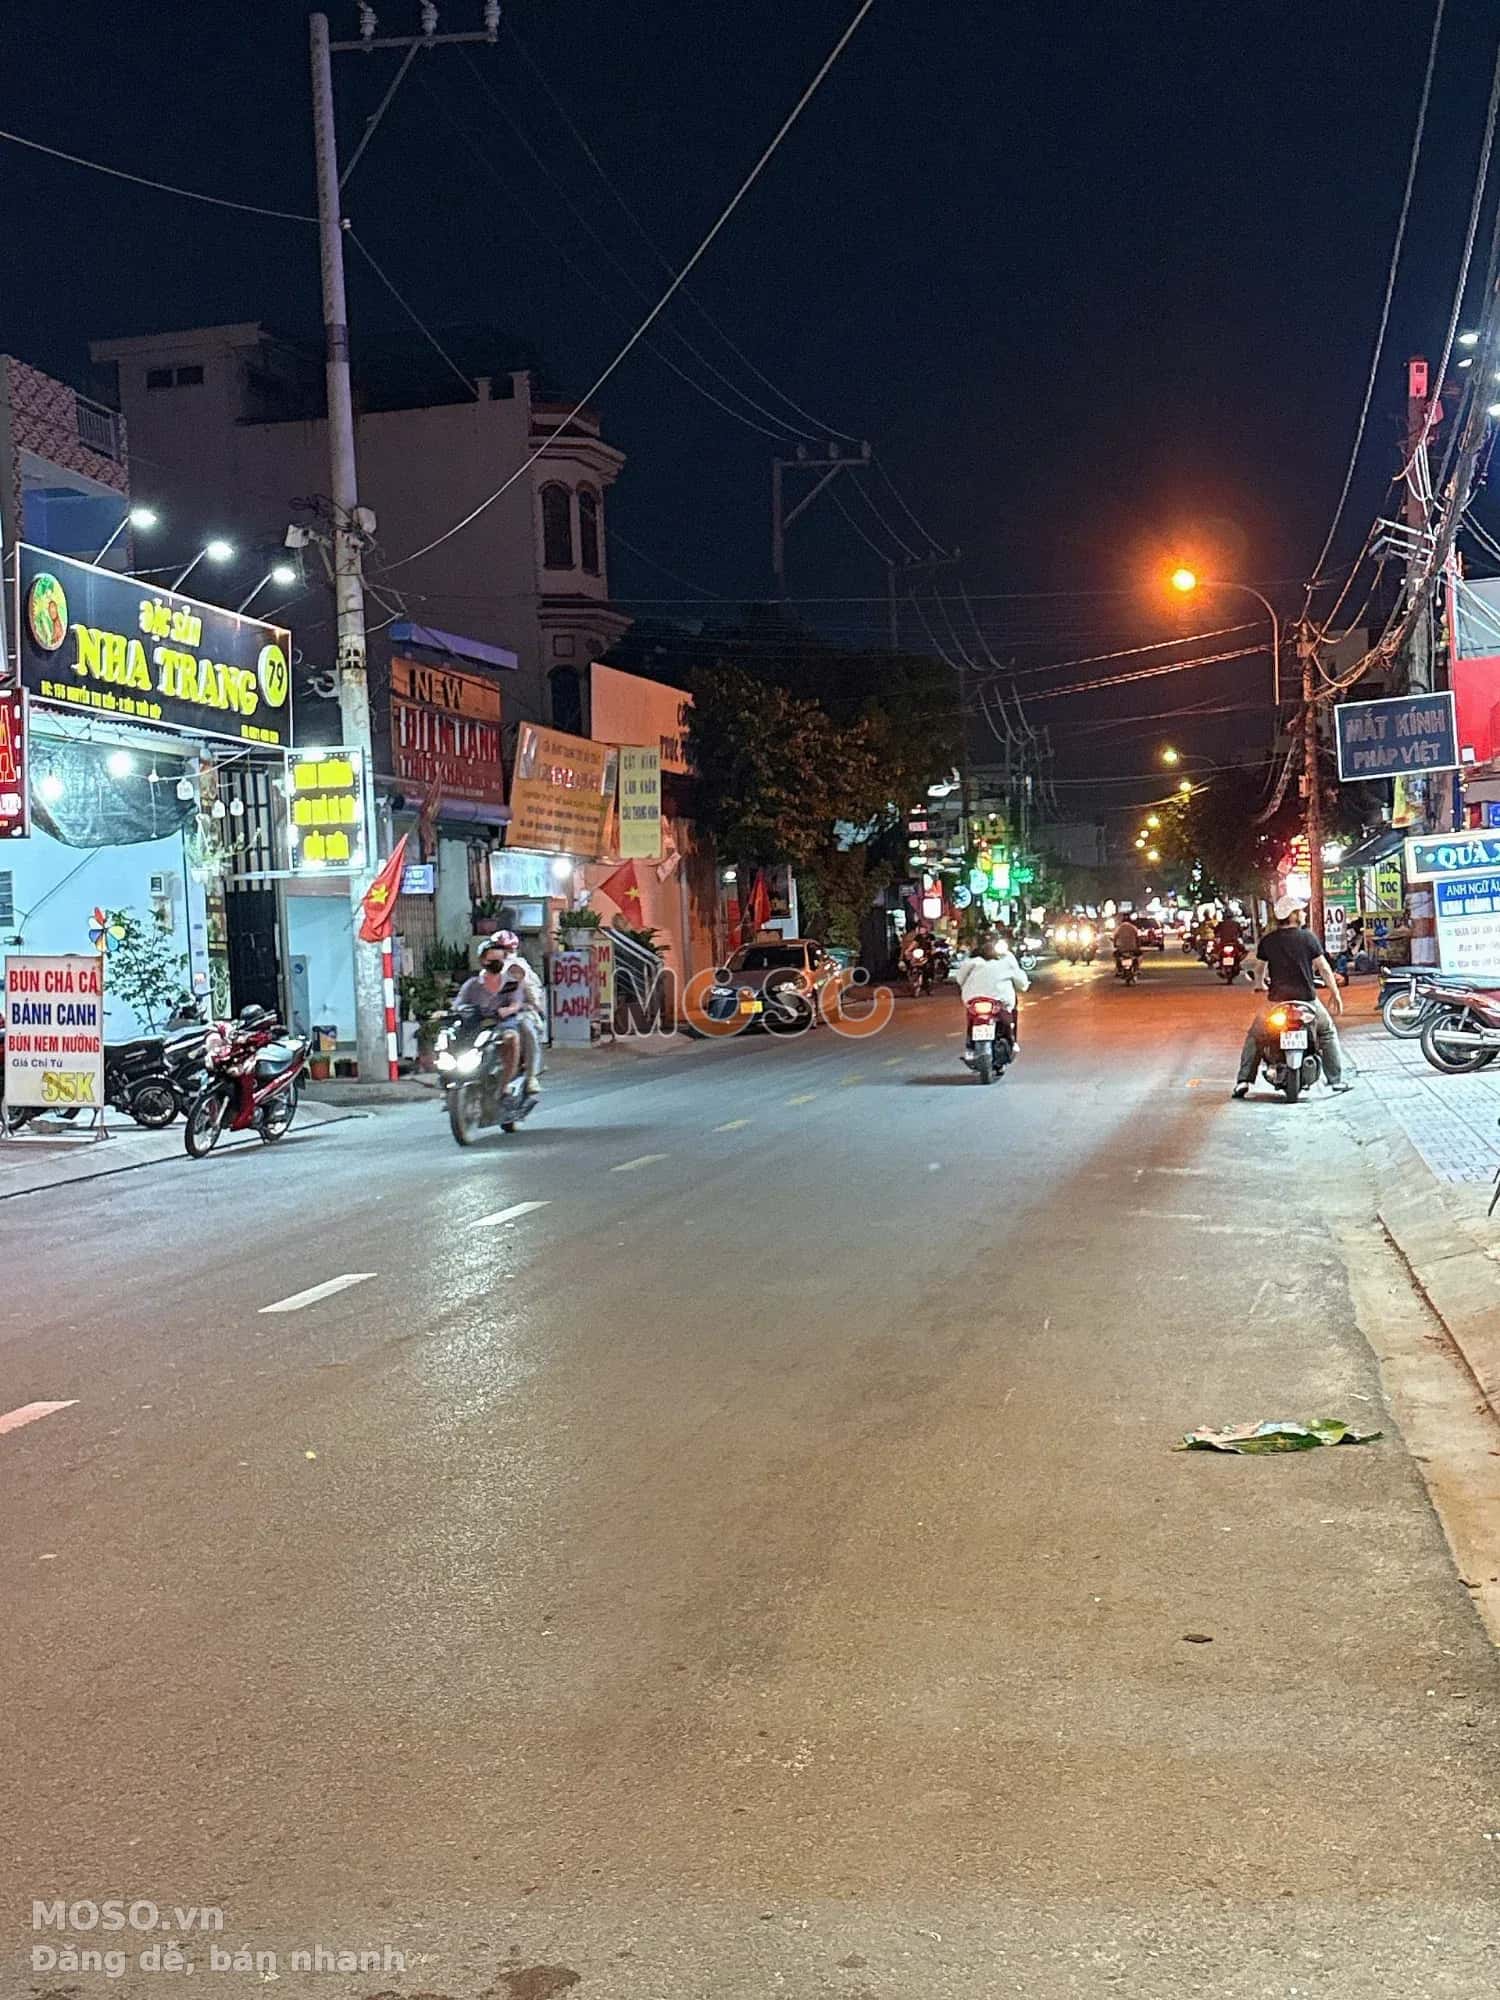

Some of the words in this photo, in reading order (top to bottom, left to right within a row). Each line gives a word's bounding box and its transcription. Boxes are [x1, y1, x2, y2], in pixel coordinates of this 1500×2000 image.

[70, 624, 152, 691] NHA
[153, 646, 259, 716] TRANG
[268, 659, 284, 692] 79
[408, 669, 463, 710] NEW
[1345, 708, 1388, 742] MẮT
[1396, 706, 1445, 737] KÍNH
[1353, 745, 1398, 769] PHÁP
[1401, 741, 1440, 765] VIỆT
[1447, 884, 1467, 896] ANH
[10, 965, 39, 993] BÚN
[45, 964, 73, 993] CHẢ
[79, 966, 97, 994] CÁ
[12, 998, 52, 1025] BÁNH
[57, 1003, 96, 1026] CANH
[9, 1032, 31, 1052] BÚN
[34, 1036, 58, 1053] NEM
[62, 1032, 100, 1053] NƯỚNG
